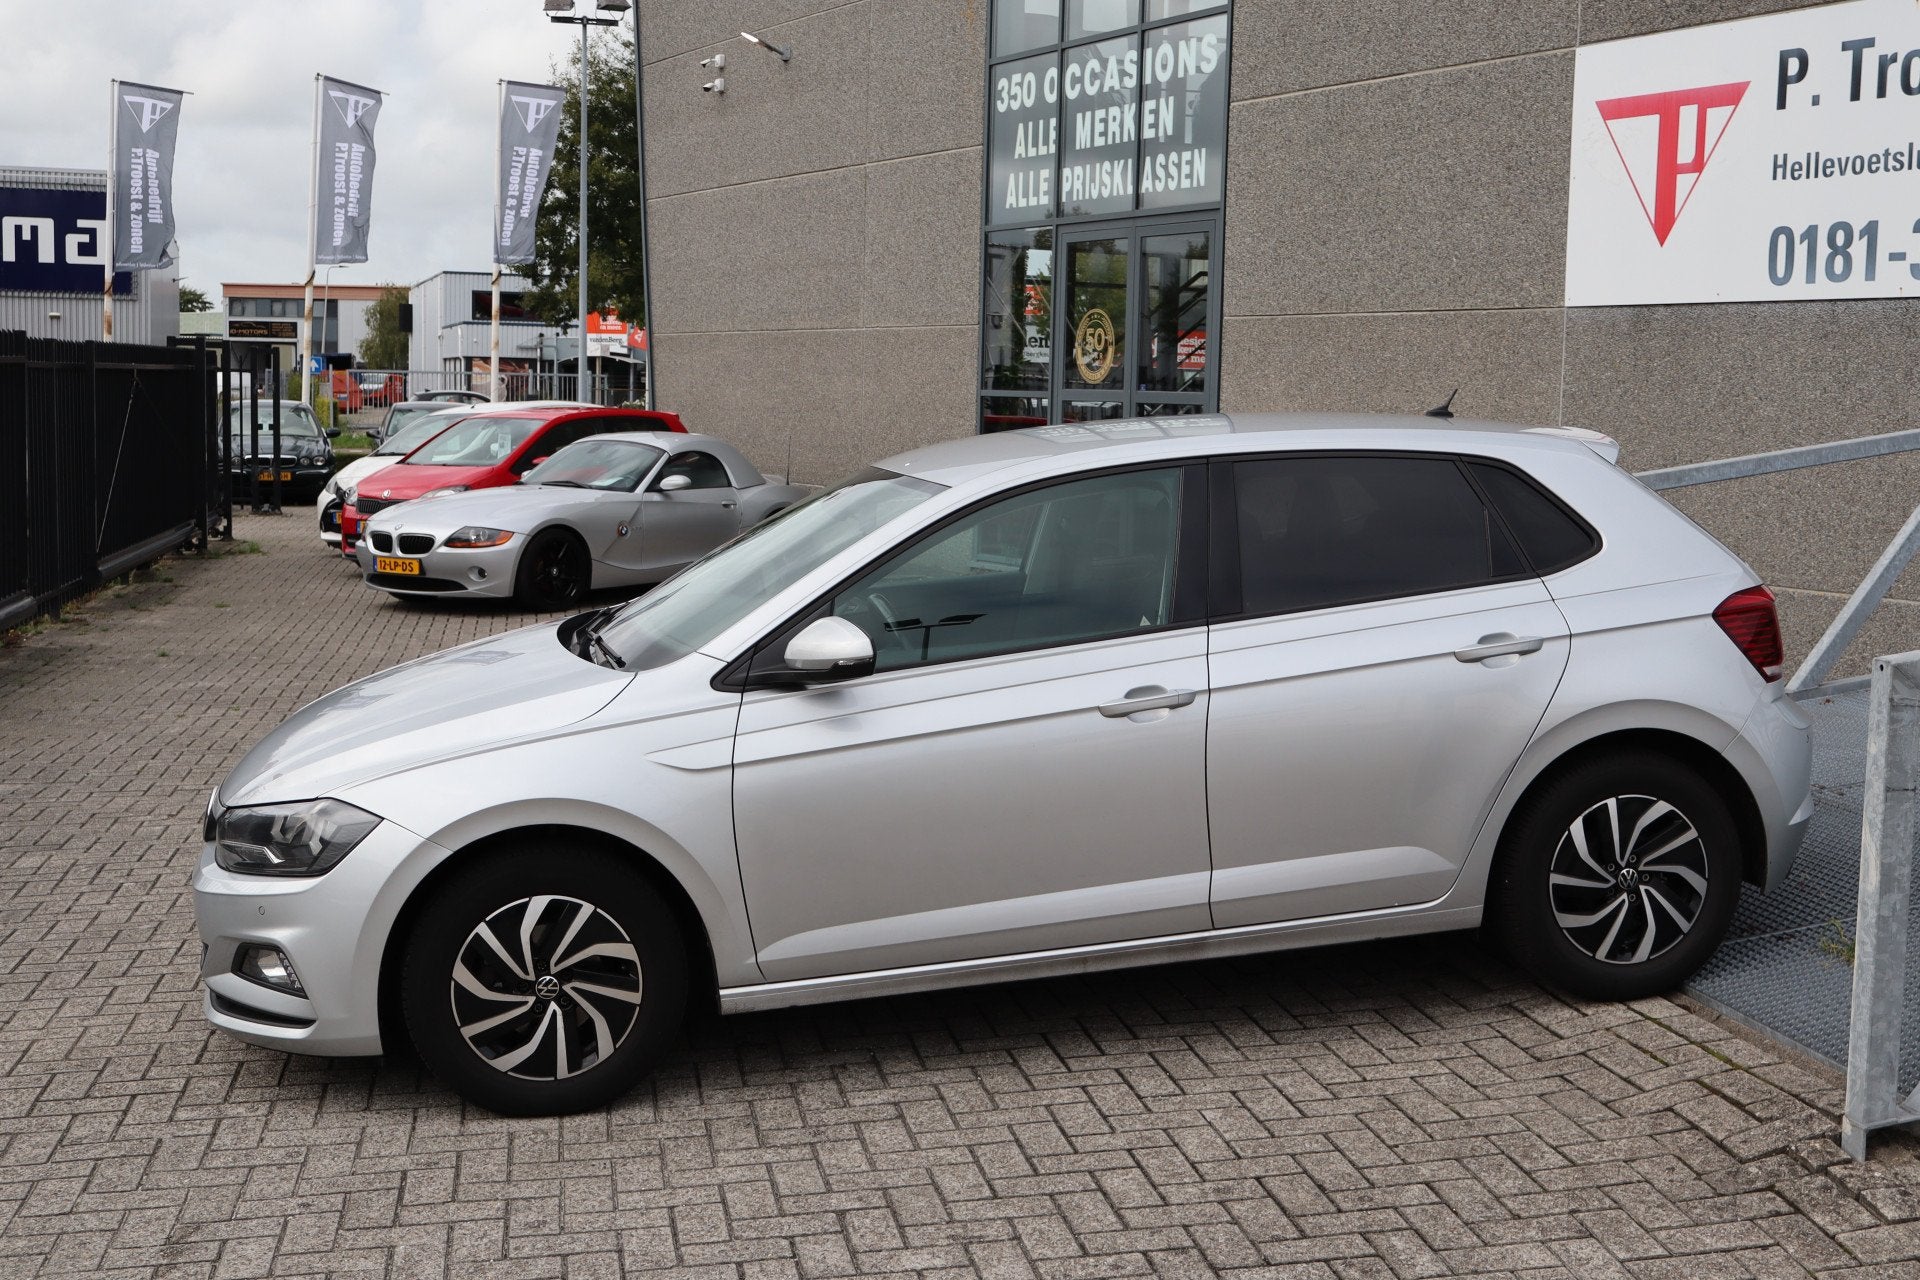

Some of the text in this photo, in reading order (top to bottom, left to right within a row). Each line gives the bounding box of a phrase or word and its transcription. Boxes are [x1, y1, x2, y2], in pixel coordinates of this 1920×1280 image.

[996, 33, 1218, 113] 350 OCCASIONS
[1776, 47, 1821, 111] P.
[1013, 96, 1175, 160] ALLE MERKEN
[347, 142, 366, 218] Autobedrijf
[1005, 147, 1207, 209] ALLE PRIJSKLASSEN
[1772, 141, 1920, 181] Hellevoetsl
[146, 148, 164, 225] Autobedrijf
[334, 196, 346, 208] &
[520, 147, 543, 218] Autobedrijf
[130, 202, 143, 212] &
[506, 198, 519, 209] &
[130, 214, 144, 254] zonen
[332, 210, 346, 247] zonen
[501, 209, 516, 246] zonen
[1085, 327, 1106, 351] 50
[379, 559, 414, 573] 12-LP-DS
